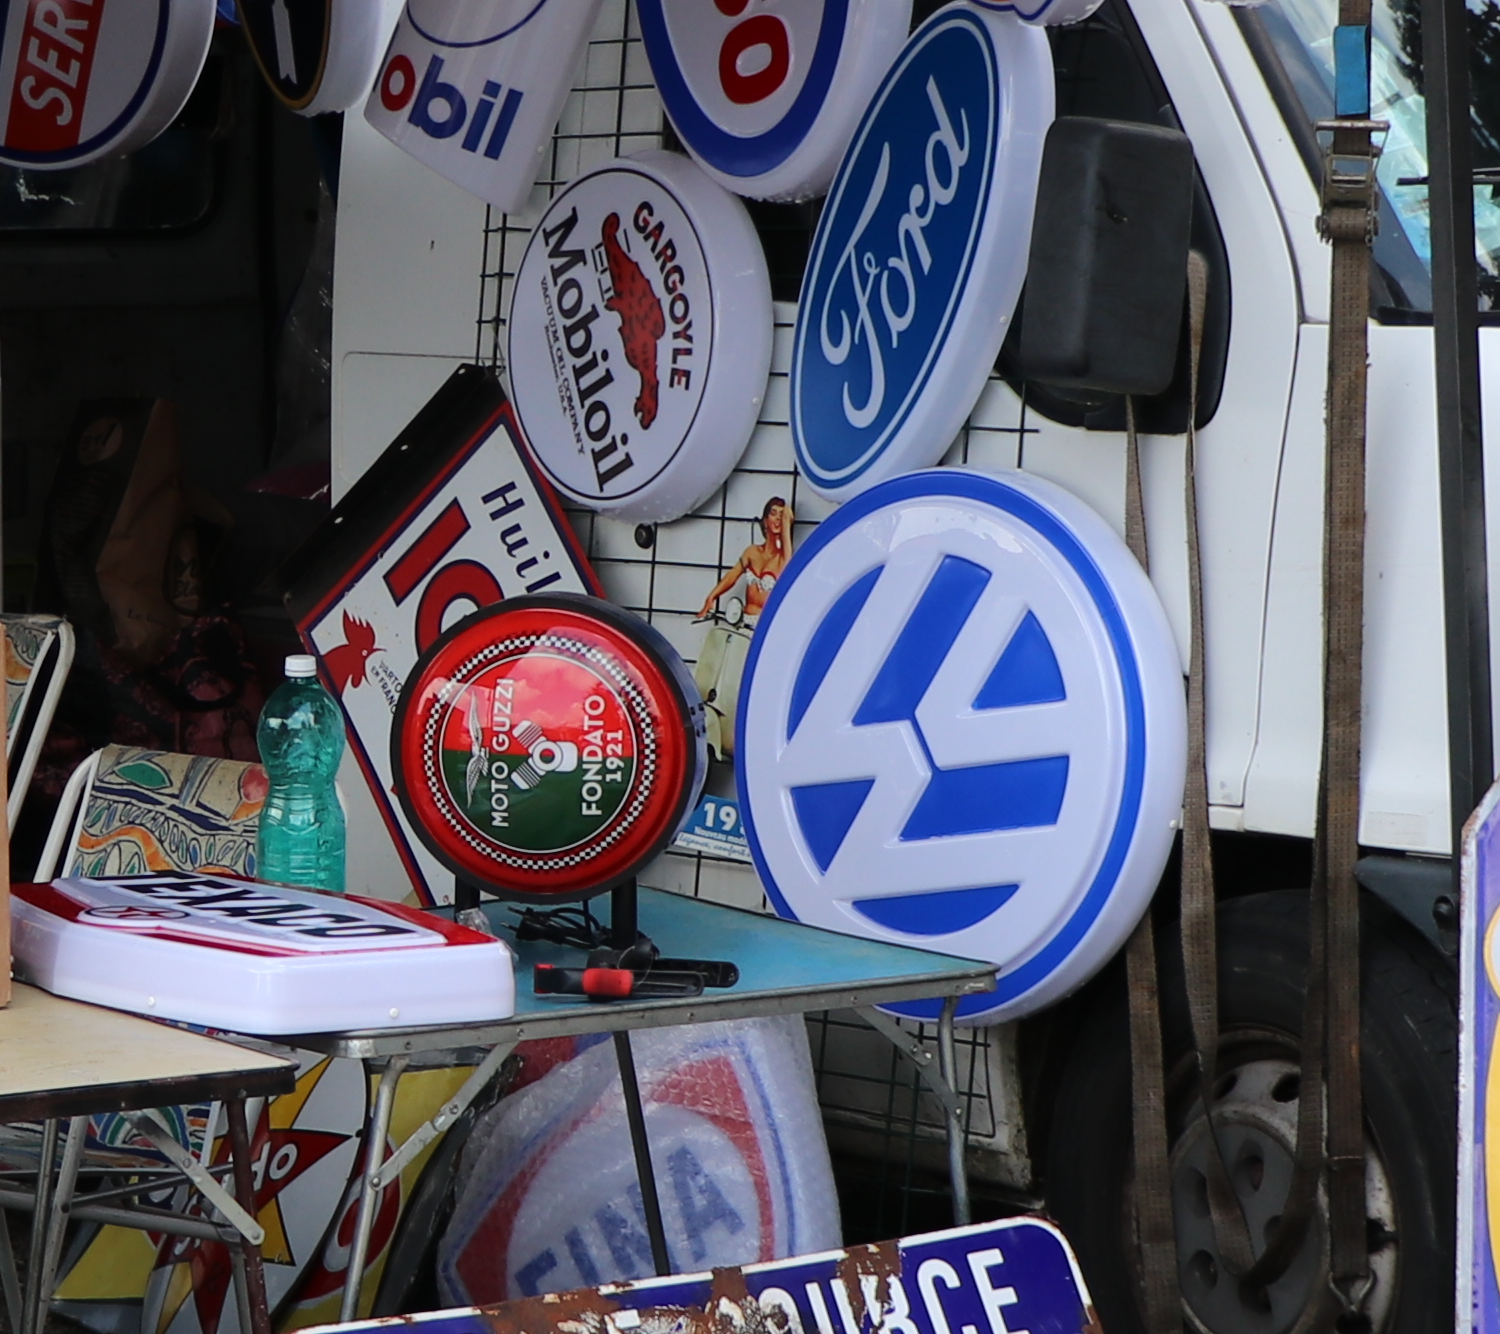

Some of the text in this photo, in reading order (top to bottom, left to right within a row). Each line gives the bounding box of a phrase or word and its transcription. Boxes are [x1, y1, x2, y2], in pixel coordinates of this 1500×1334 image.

[380, 54, 523, 161] obil
[633, 201, 693, 391] GARGOYLE
[822, 75, 970, 428] Ford
[541, 275, 585, 455] VACUUM OIL COMPANY
[543, 206, 634, 493] Mobiloil
[481, 480, 562, 593] Huil
[378, 677, 398, 715] FRANC
[491, 678, 514, 828] MOTO GUZZI
[582, 694, 606, 816] FONDATO
[605, 729, 625, 783] 1921
[704, 802, 744, 833] 19
[84, 870, 416, 938] TEXACO
